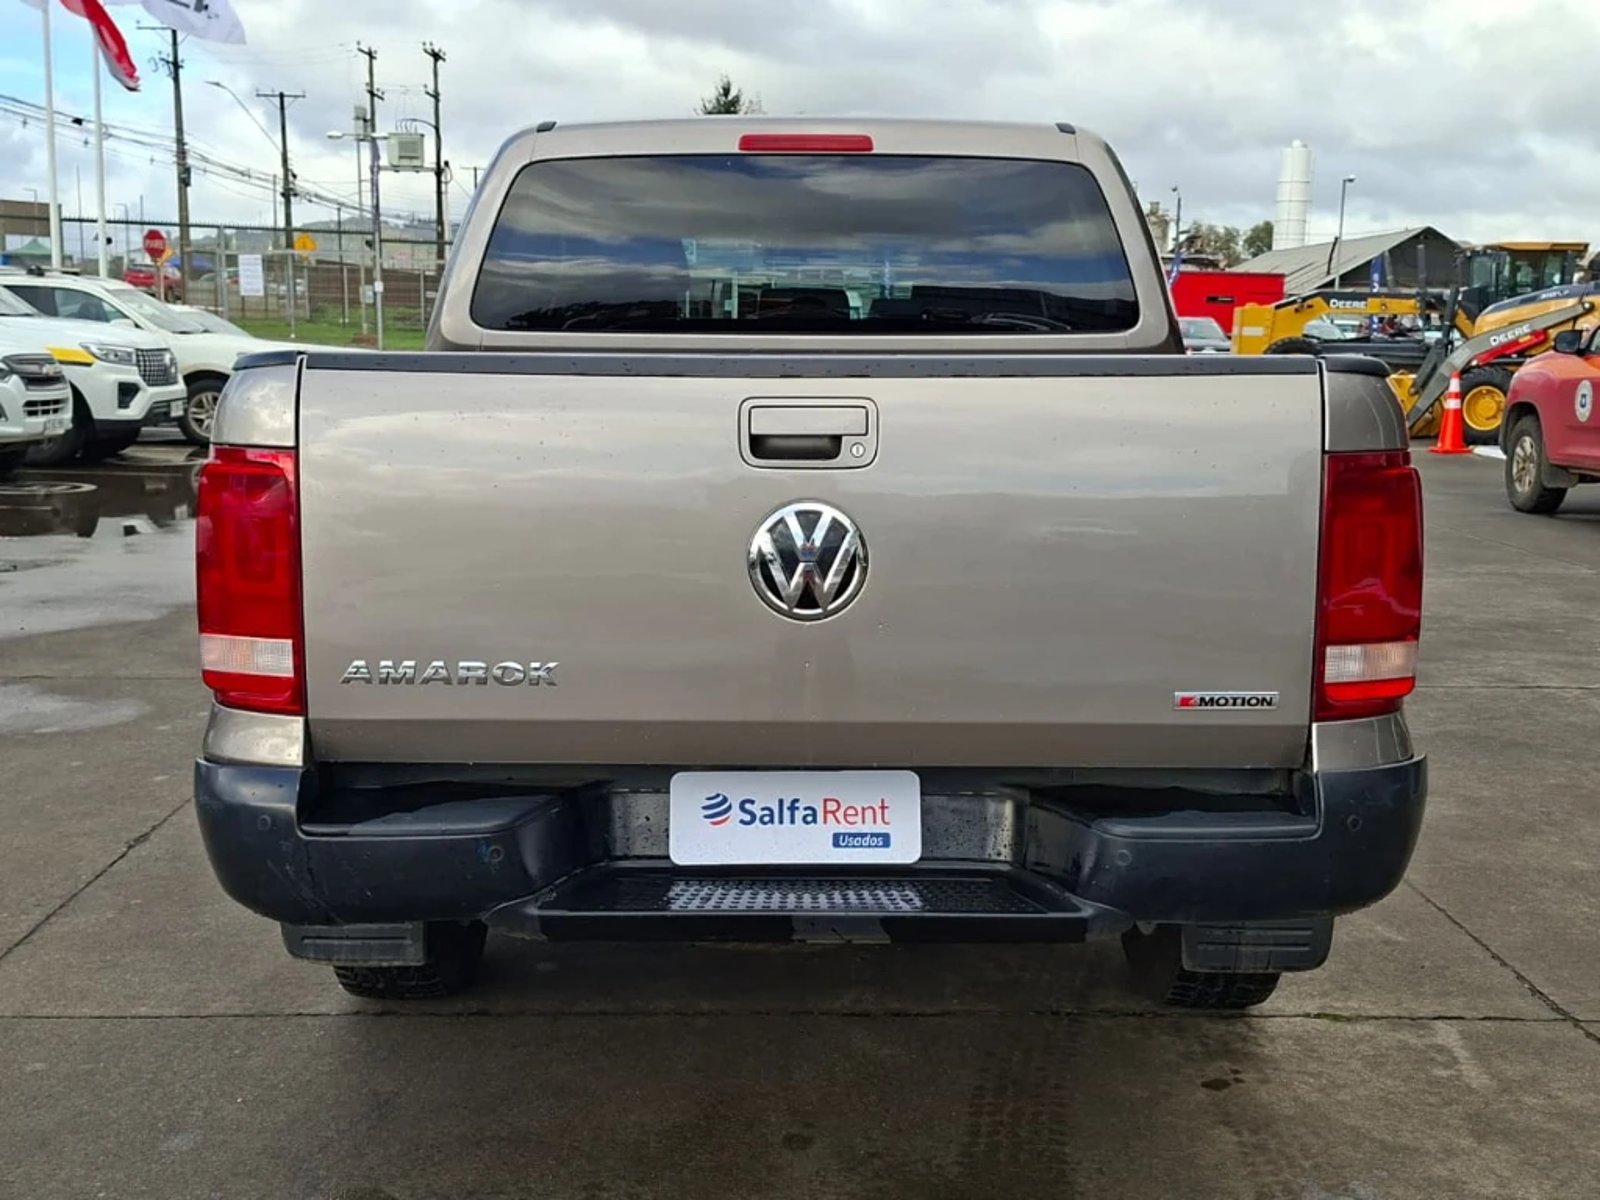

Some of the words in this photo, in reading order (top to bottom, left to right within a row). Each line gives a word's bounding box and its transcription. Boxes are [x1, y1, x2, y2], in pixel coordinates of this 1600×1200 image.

[1490, 323, 1531, 346] DEERE
[340, 659, 560, 687] AMAROK
[738, 798, 891, 826] SalfaRent
[838, 833, 884, 847] Usados
